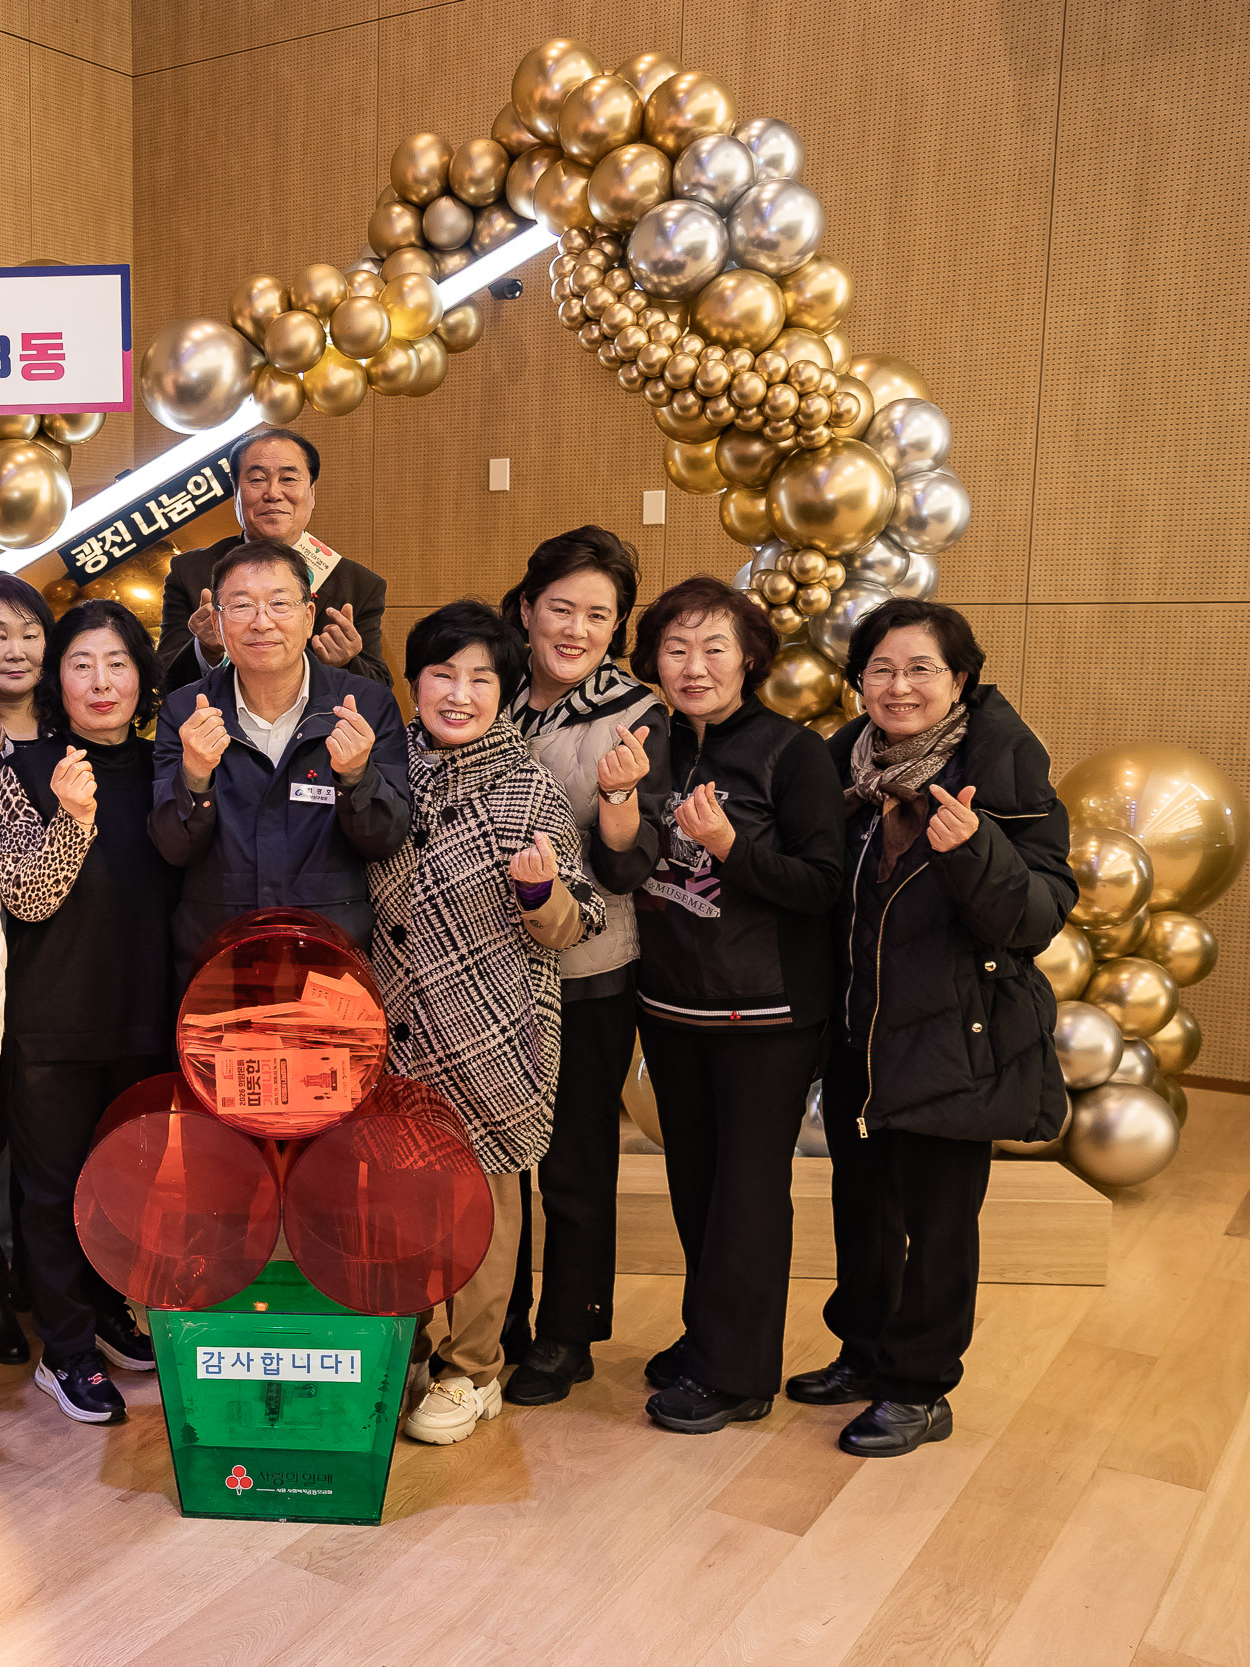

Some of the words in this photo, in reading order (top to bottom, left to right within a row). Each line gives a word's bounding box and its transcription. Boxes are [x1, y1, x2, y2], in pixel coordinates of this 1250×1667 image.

[70, 520, 136, 574] 광진
[131, 466, 225, 536] 나눔의
[238, 1088, 246, 1106] 2026
[246, 1058, 261, 1106] 따뜻한
[201, 1351, 356, 1376] 감사합니다!
